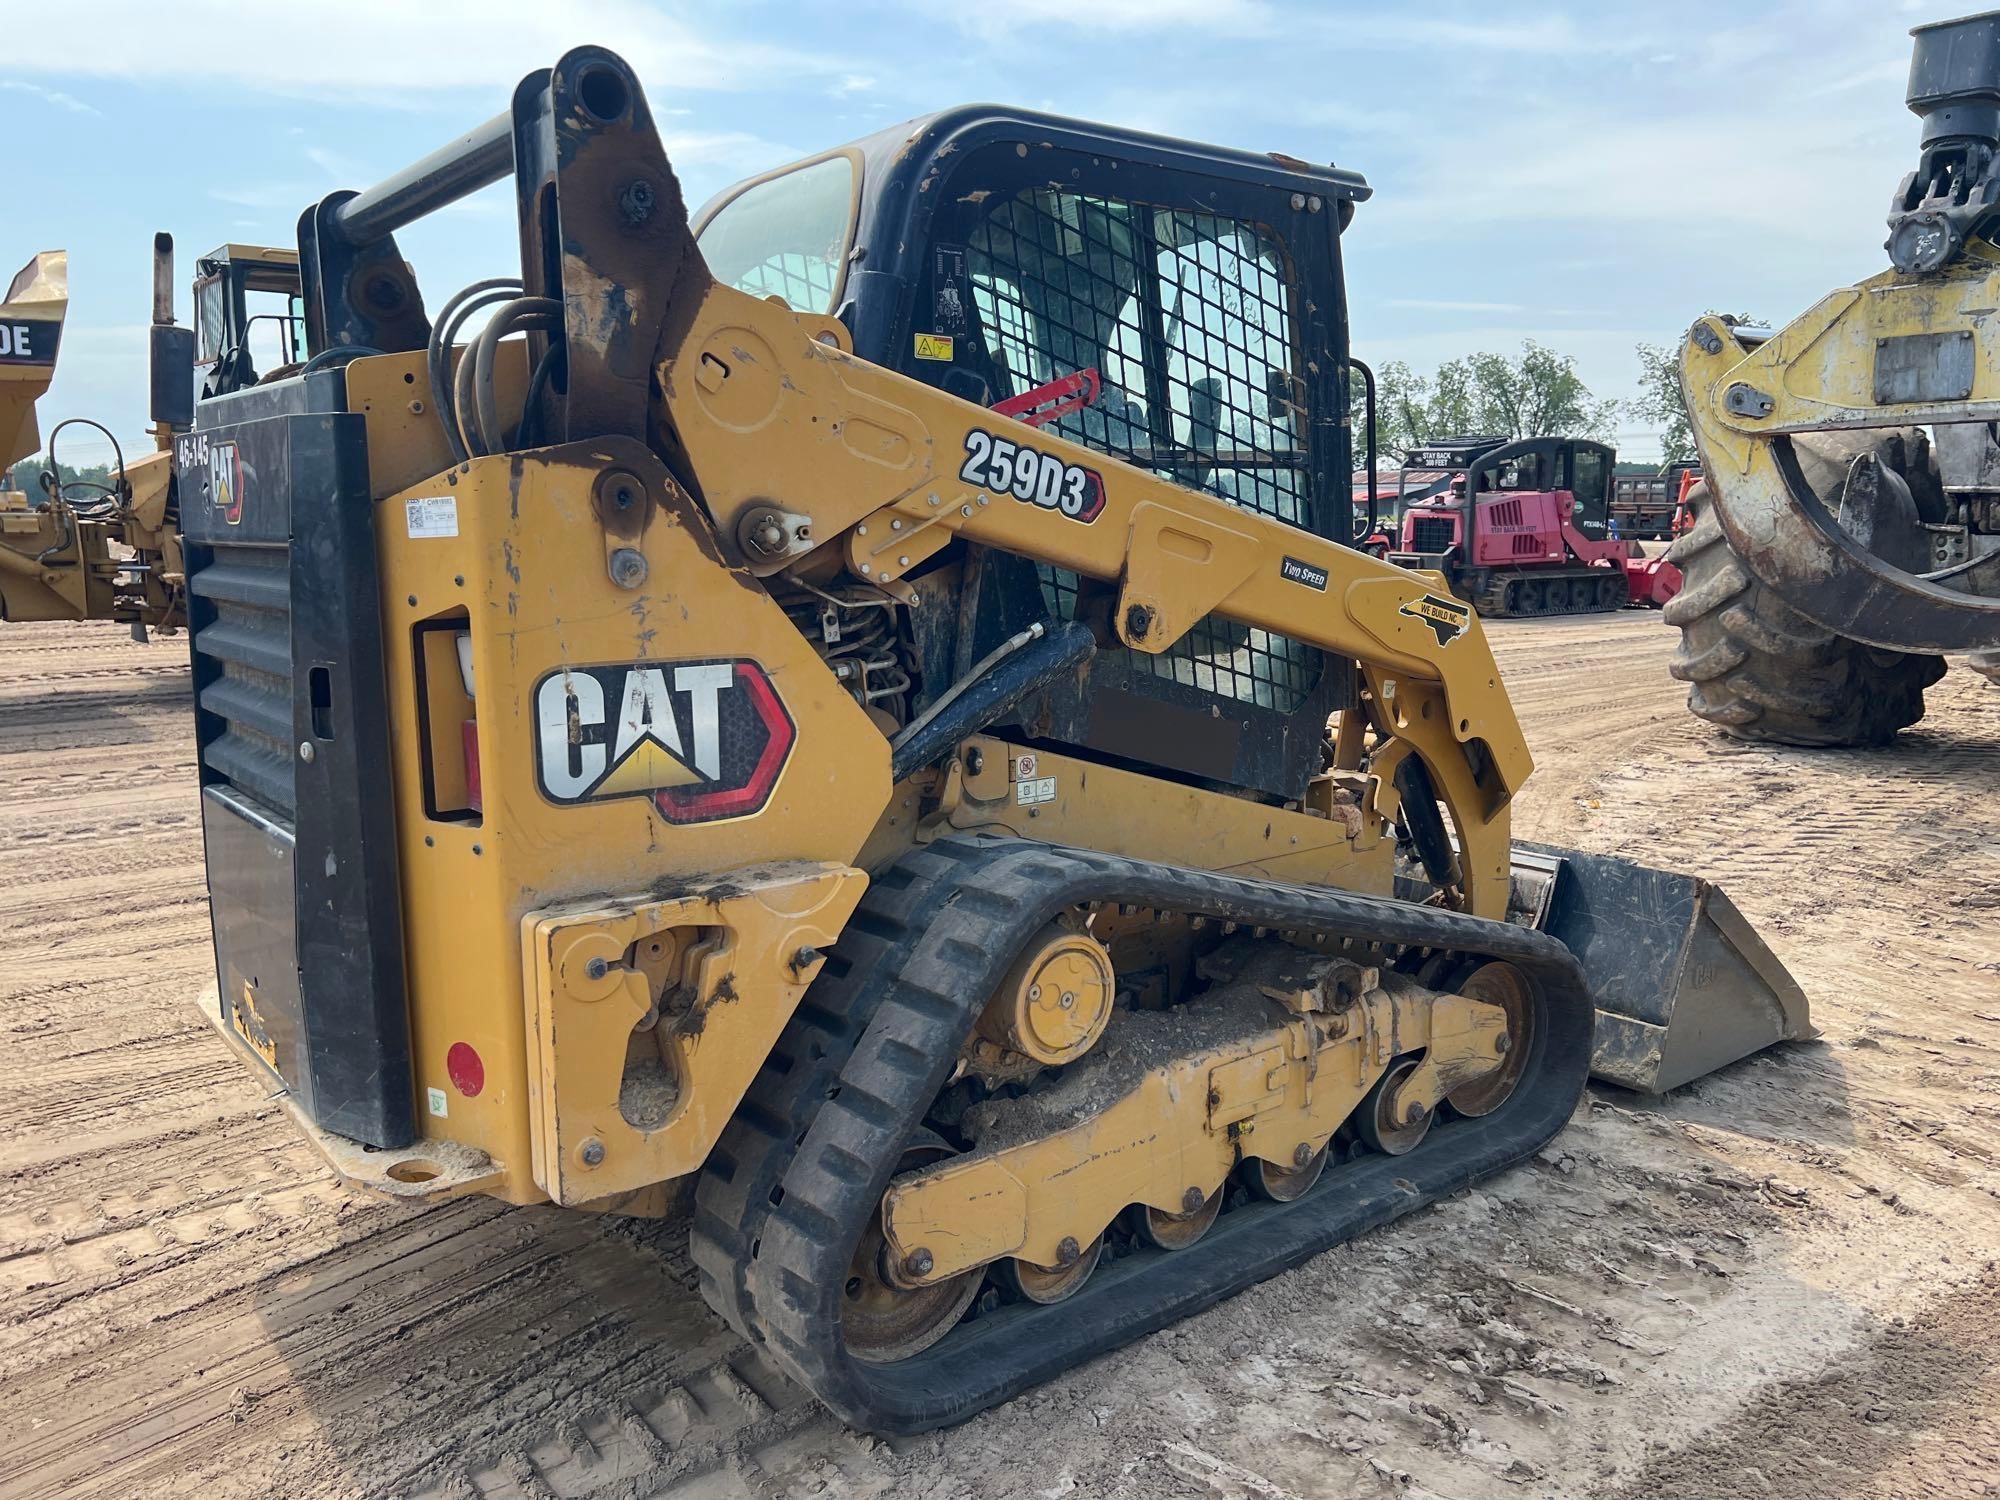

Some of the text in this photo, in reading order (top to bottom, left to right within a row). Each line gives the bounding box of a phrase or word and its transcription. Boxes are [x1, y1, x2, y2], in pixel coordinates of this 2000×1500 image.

[179, 435, 209, 468] 46-145
[210, 445, 234, 504] CAT
[961, 431, 1086, 515] 259D3
[1436, 452, 1451, 460] BACK
[1421, 603, 1458, 623] WE BUILD NC
[537, 663, 733, 799] CAT
